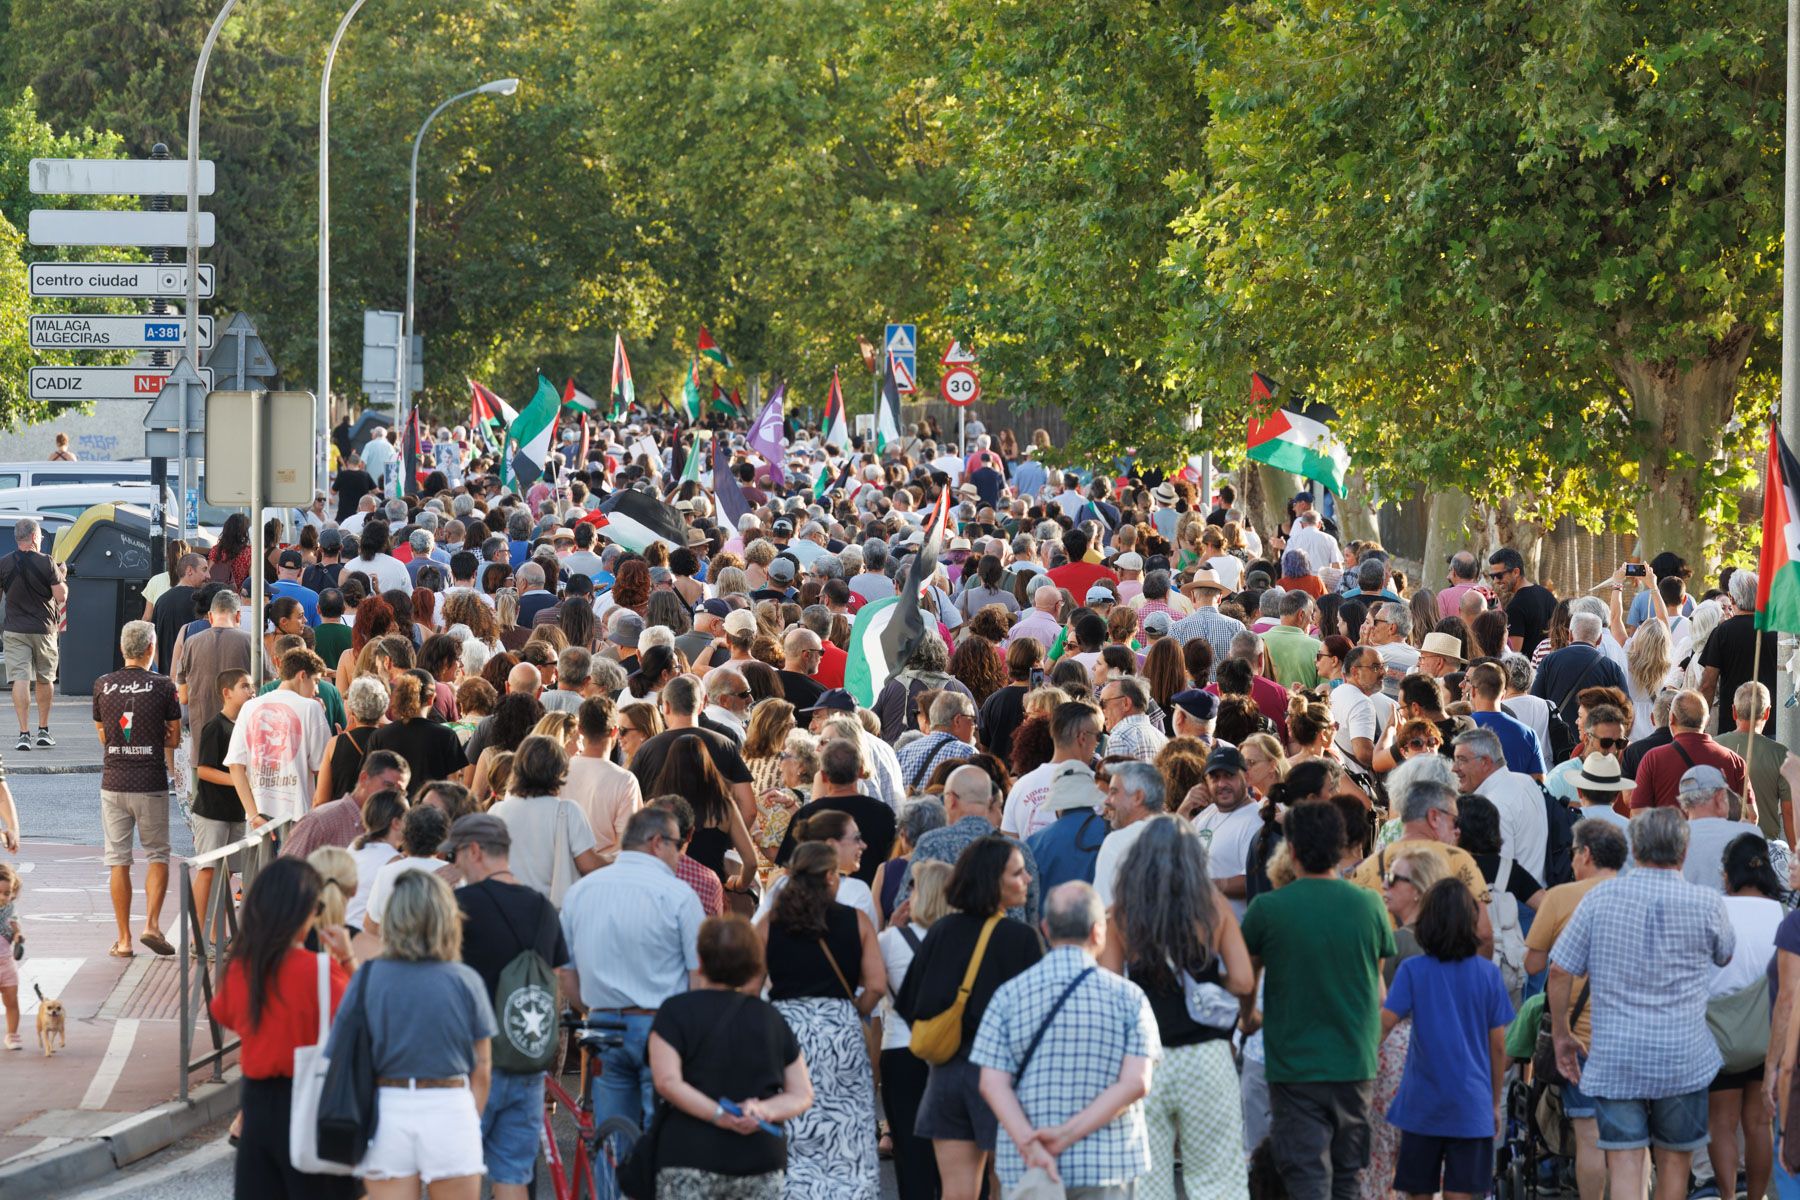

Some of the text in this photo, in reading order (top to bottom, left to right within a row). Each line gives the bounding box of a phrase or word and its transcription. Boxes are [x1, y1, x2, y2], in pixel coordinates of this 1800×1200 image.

[36, 273, 138, 287] centro ciudad
[35, 320, 91, 331] MALAGA
[35, 332, 110, 344] ALGECIRAS
[146, 327, 179, 338] A-381
[35, 377, 82, 390] CADIZ
[138, 377, 169, 391] N-I
[950, 380, 972, 392] 30
[121, 745, 153, 755] PALESTINE
